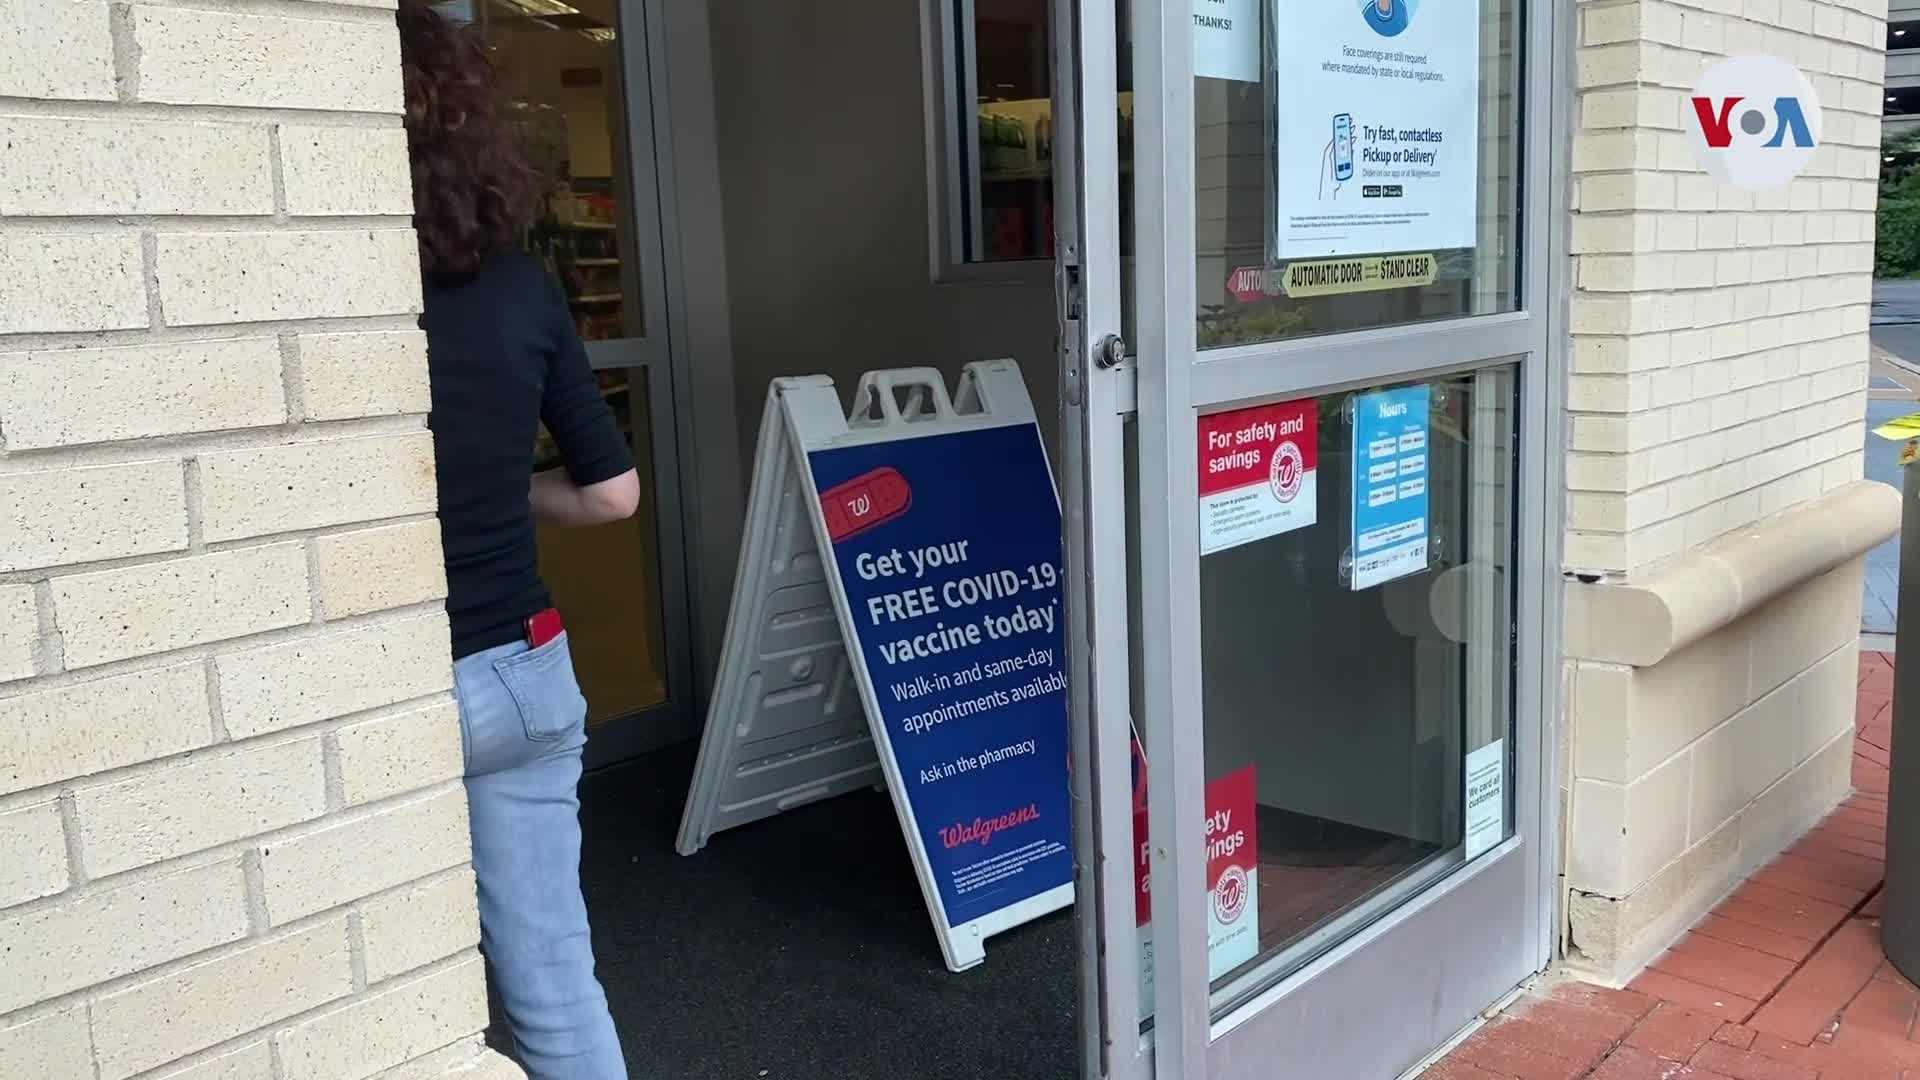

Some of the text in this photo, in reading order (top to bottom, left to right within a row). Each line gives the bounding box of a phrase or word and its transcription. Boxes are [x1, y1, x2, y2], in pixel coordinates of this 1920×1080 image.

[1193, 14, 1232, 30] THANKS!
[1343, 45, 1427, 65] Face coverings are still required
[1322, 60, 1340, 72] where
[1341, 63, 1370, 75] mandated
[1371, 65, 1378, 78] by
[1380, 68, 1393, 77] state
[1394, 70, 1400, 78] or
[1401, 69, 1413, 79] local
[1363, 125, 1442, 144] Try fast, contactless
[1363, 147, 1391, 166] Pickup
[1393, 151, 1402, 162] or
[1291, 263, 1339, 287] AUTOMATIC
[1341, 263, 1362, 282] DOOR
[1381, 259, 1404, 280] STAND
[1407, 257, 1429, 278] CLEAR
[1379, 403, 1407, 419] Hours
[1209, 413, 1303, 450] For safety and
[1209, 449, 1260, 473] savings
[856, 540, 968, 580] Get your
[867, 562, 1057, 625] FREE COVID-19
[879, 623, 982, 665] vaccine
[890, 647, 1053, 702] Walk-in and same-day
[902, 690, 1009, 734] appointments
[920, 739, 1036, 785] Ask in the pharmacy
[1468, 787, 1500, 808] customers
[938, 803, 1041, 848] Walgreens
[1206, 809, 1231, 835] ety
